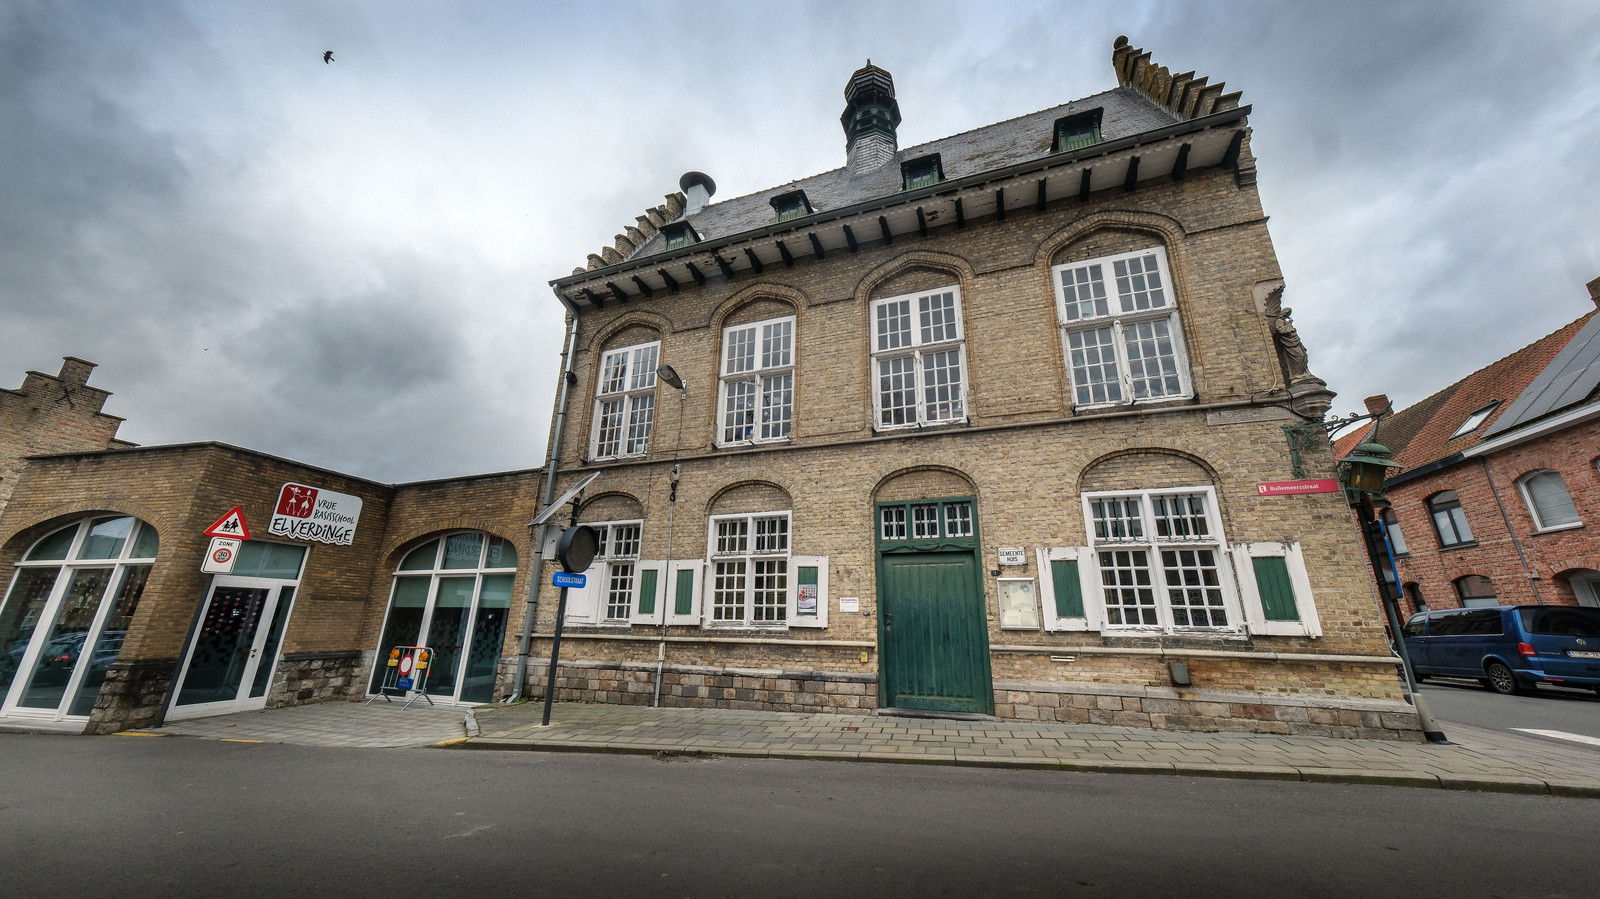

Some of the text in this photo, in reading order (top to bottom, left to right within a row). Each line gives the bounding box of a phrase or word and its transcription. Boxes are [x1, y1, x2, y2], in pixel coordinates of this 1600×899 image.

[318, 499, 337, 510] VRIJE
[314, 509, 354, 524] BASISSCHOOL
[557, 576, 584, 584] SCHOOLSTRAAT
